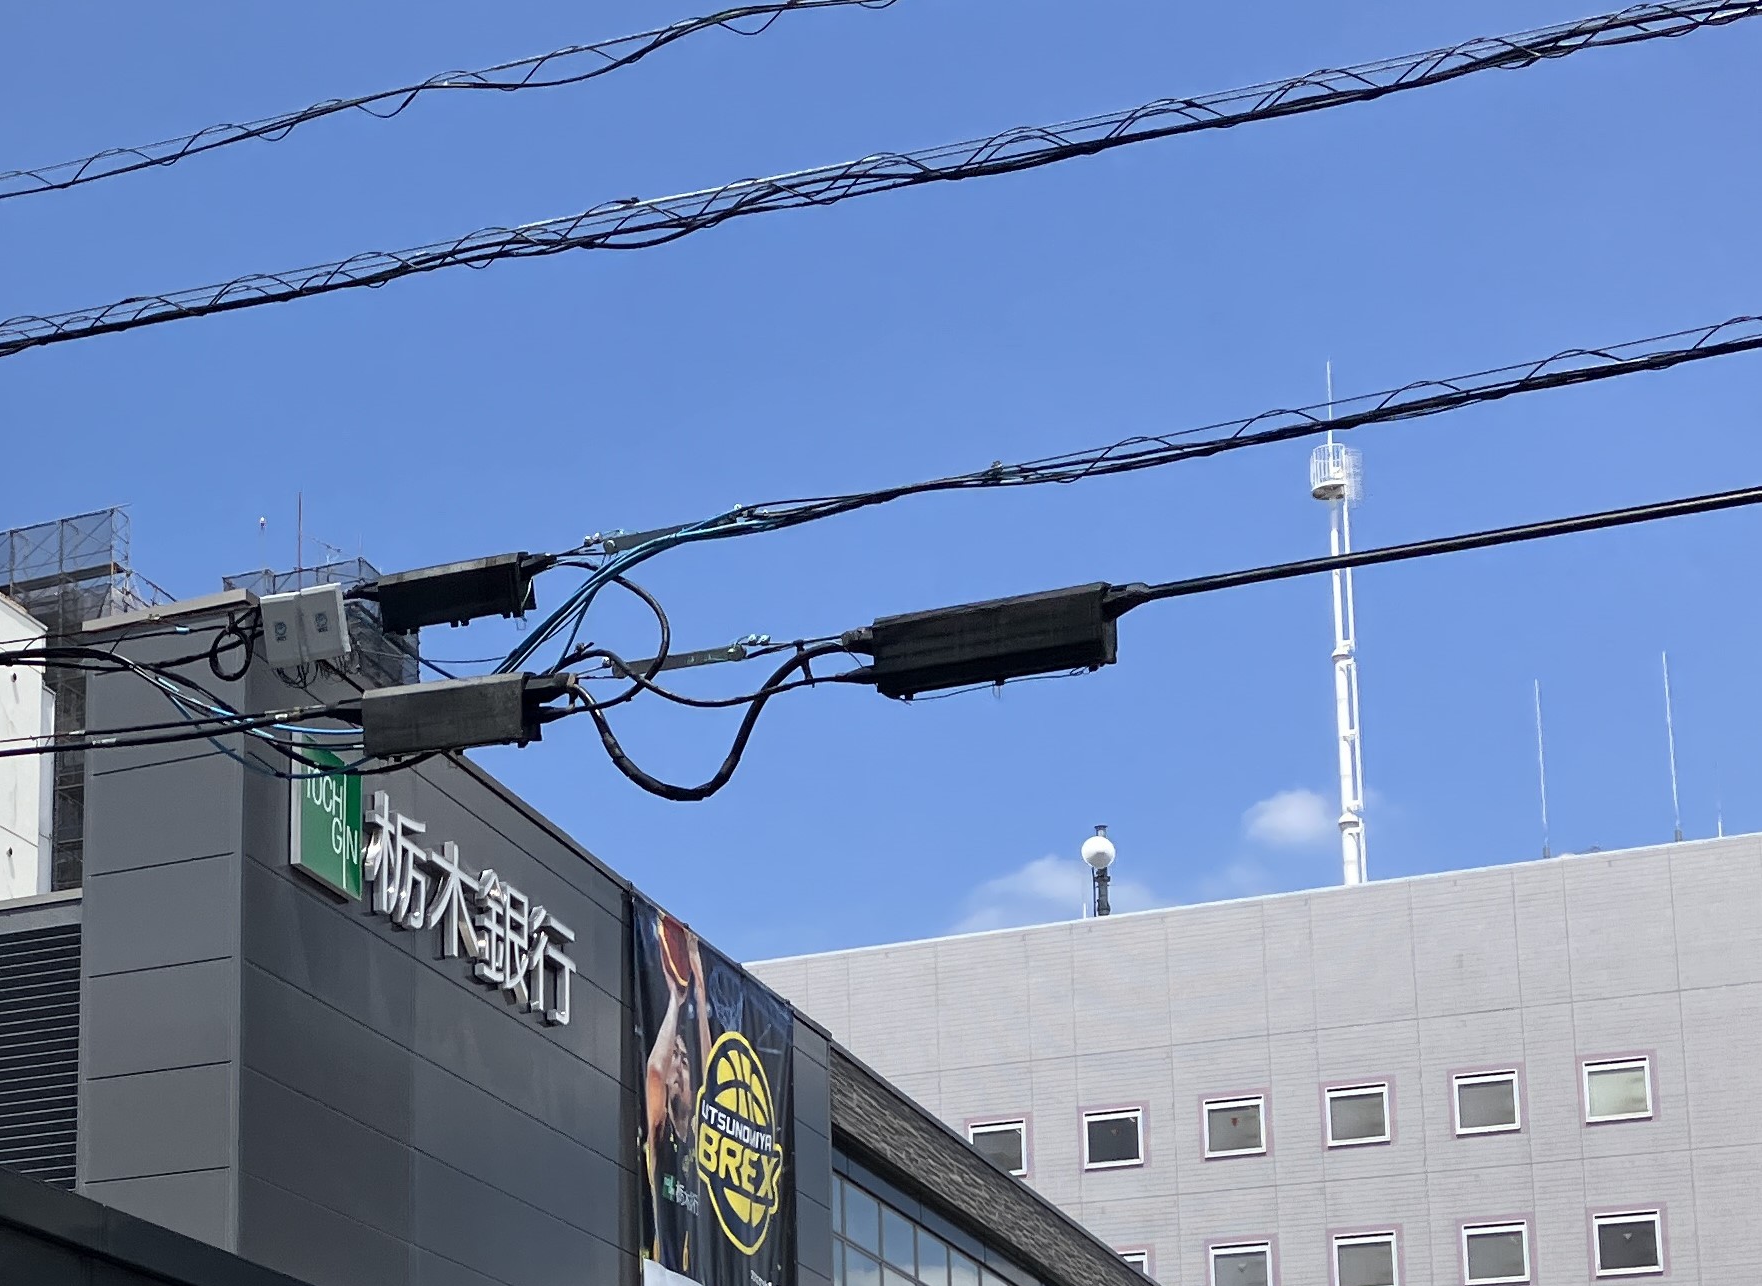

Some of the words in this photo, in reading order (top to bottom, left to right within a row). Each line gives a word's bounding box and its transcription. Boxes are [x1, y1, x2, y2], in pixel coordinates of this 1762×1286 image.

[332, 817, 358, 865] GIN
[363, 790, 576, 1025] 栃木銀行
[701, 1100, 772, 1152] UTSUNOMIYA
[698, 1122, 778, 1200] BREX
